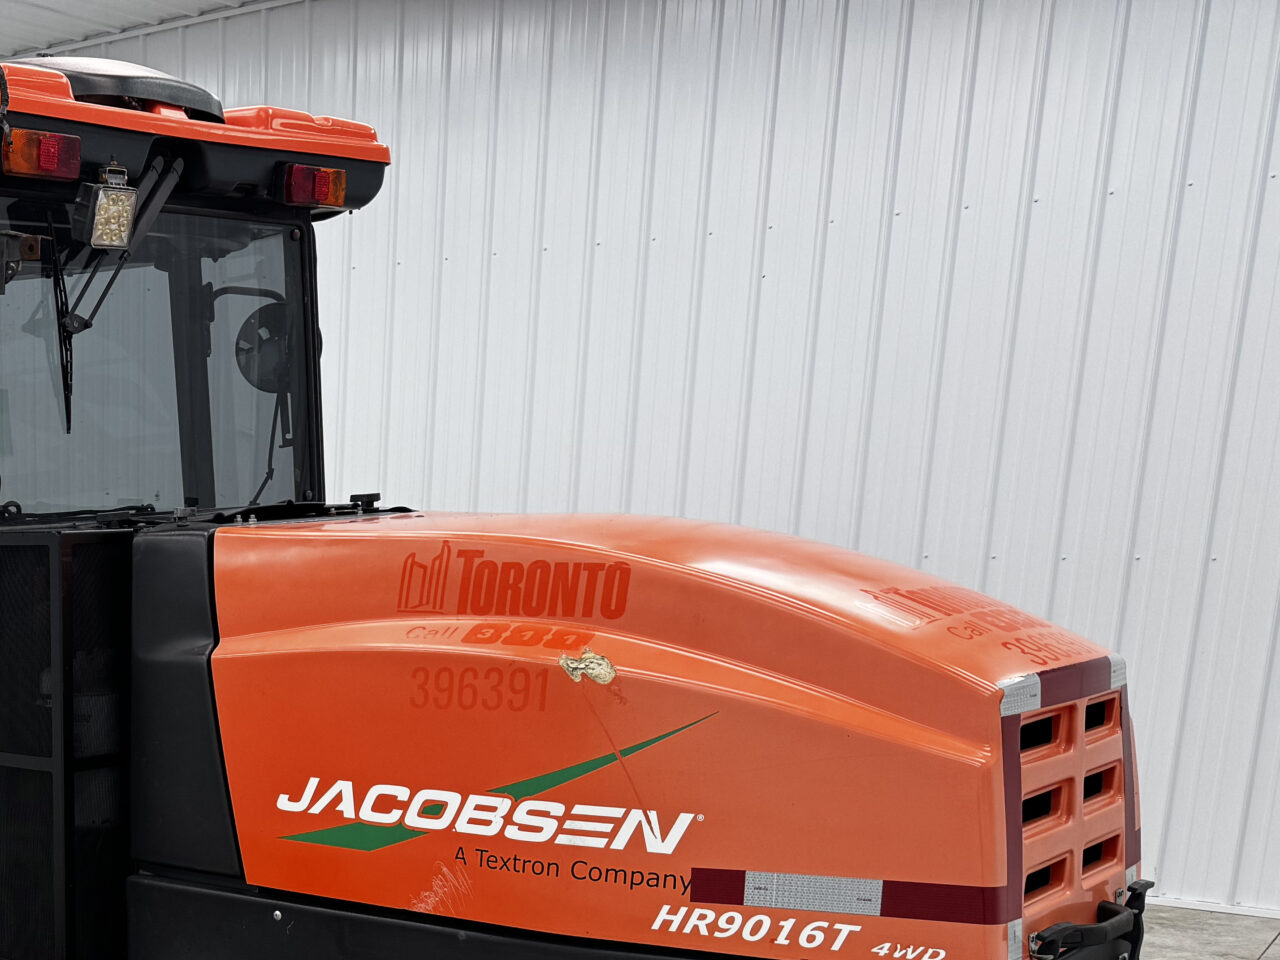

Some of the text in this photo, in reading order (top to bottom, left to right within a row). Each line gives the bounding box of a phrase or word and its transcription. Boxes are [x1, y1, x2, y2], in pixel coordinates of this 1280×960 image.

[456, 548, 632, 620] TORONTO
[405, 625, 580, 646] Call 311
[408, 665, 550, 713] 396391
[276, 776, 695, 855] JACOBSEN
[454, 846, 693, 896] A Textron Company
[650, 903, 862, 952] HR9016T
